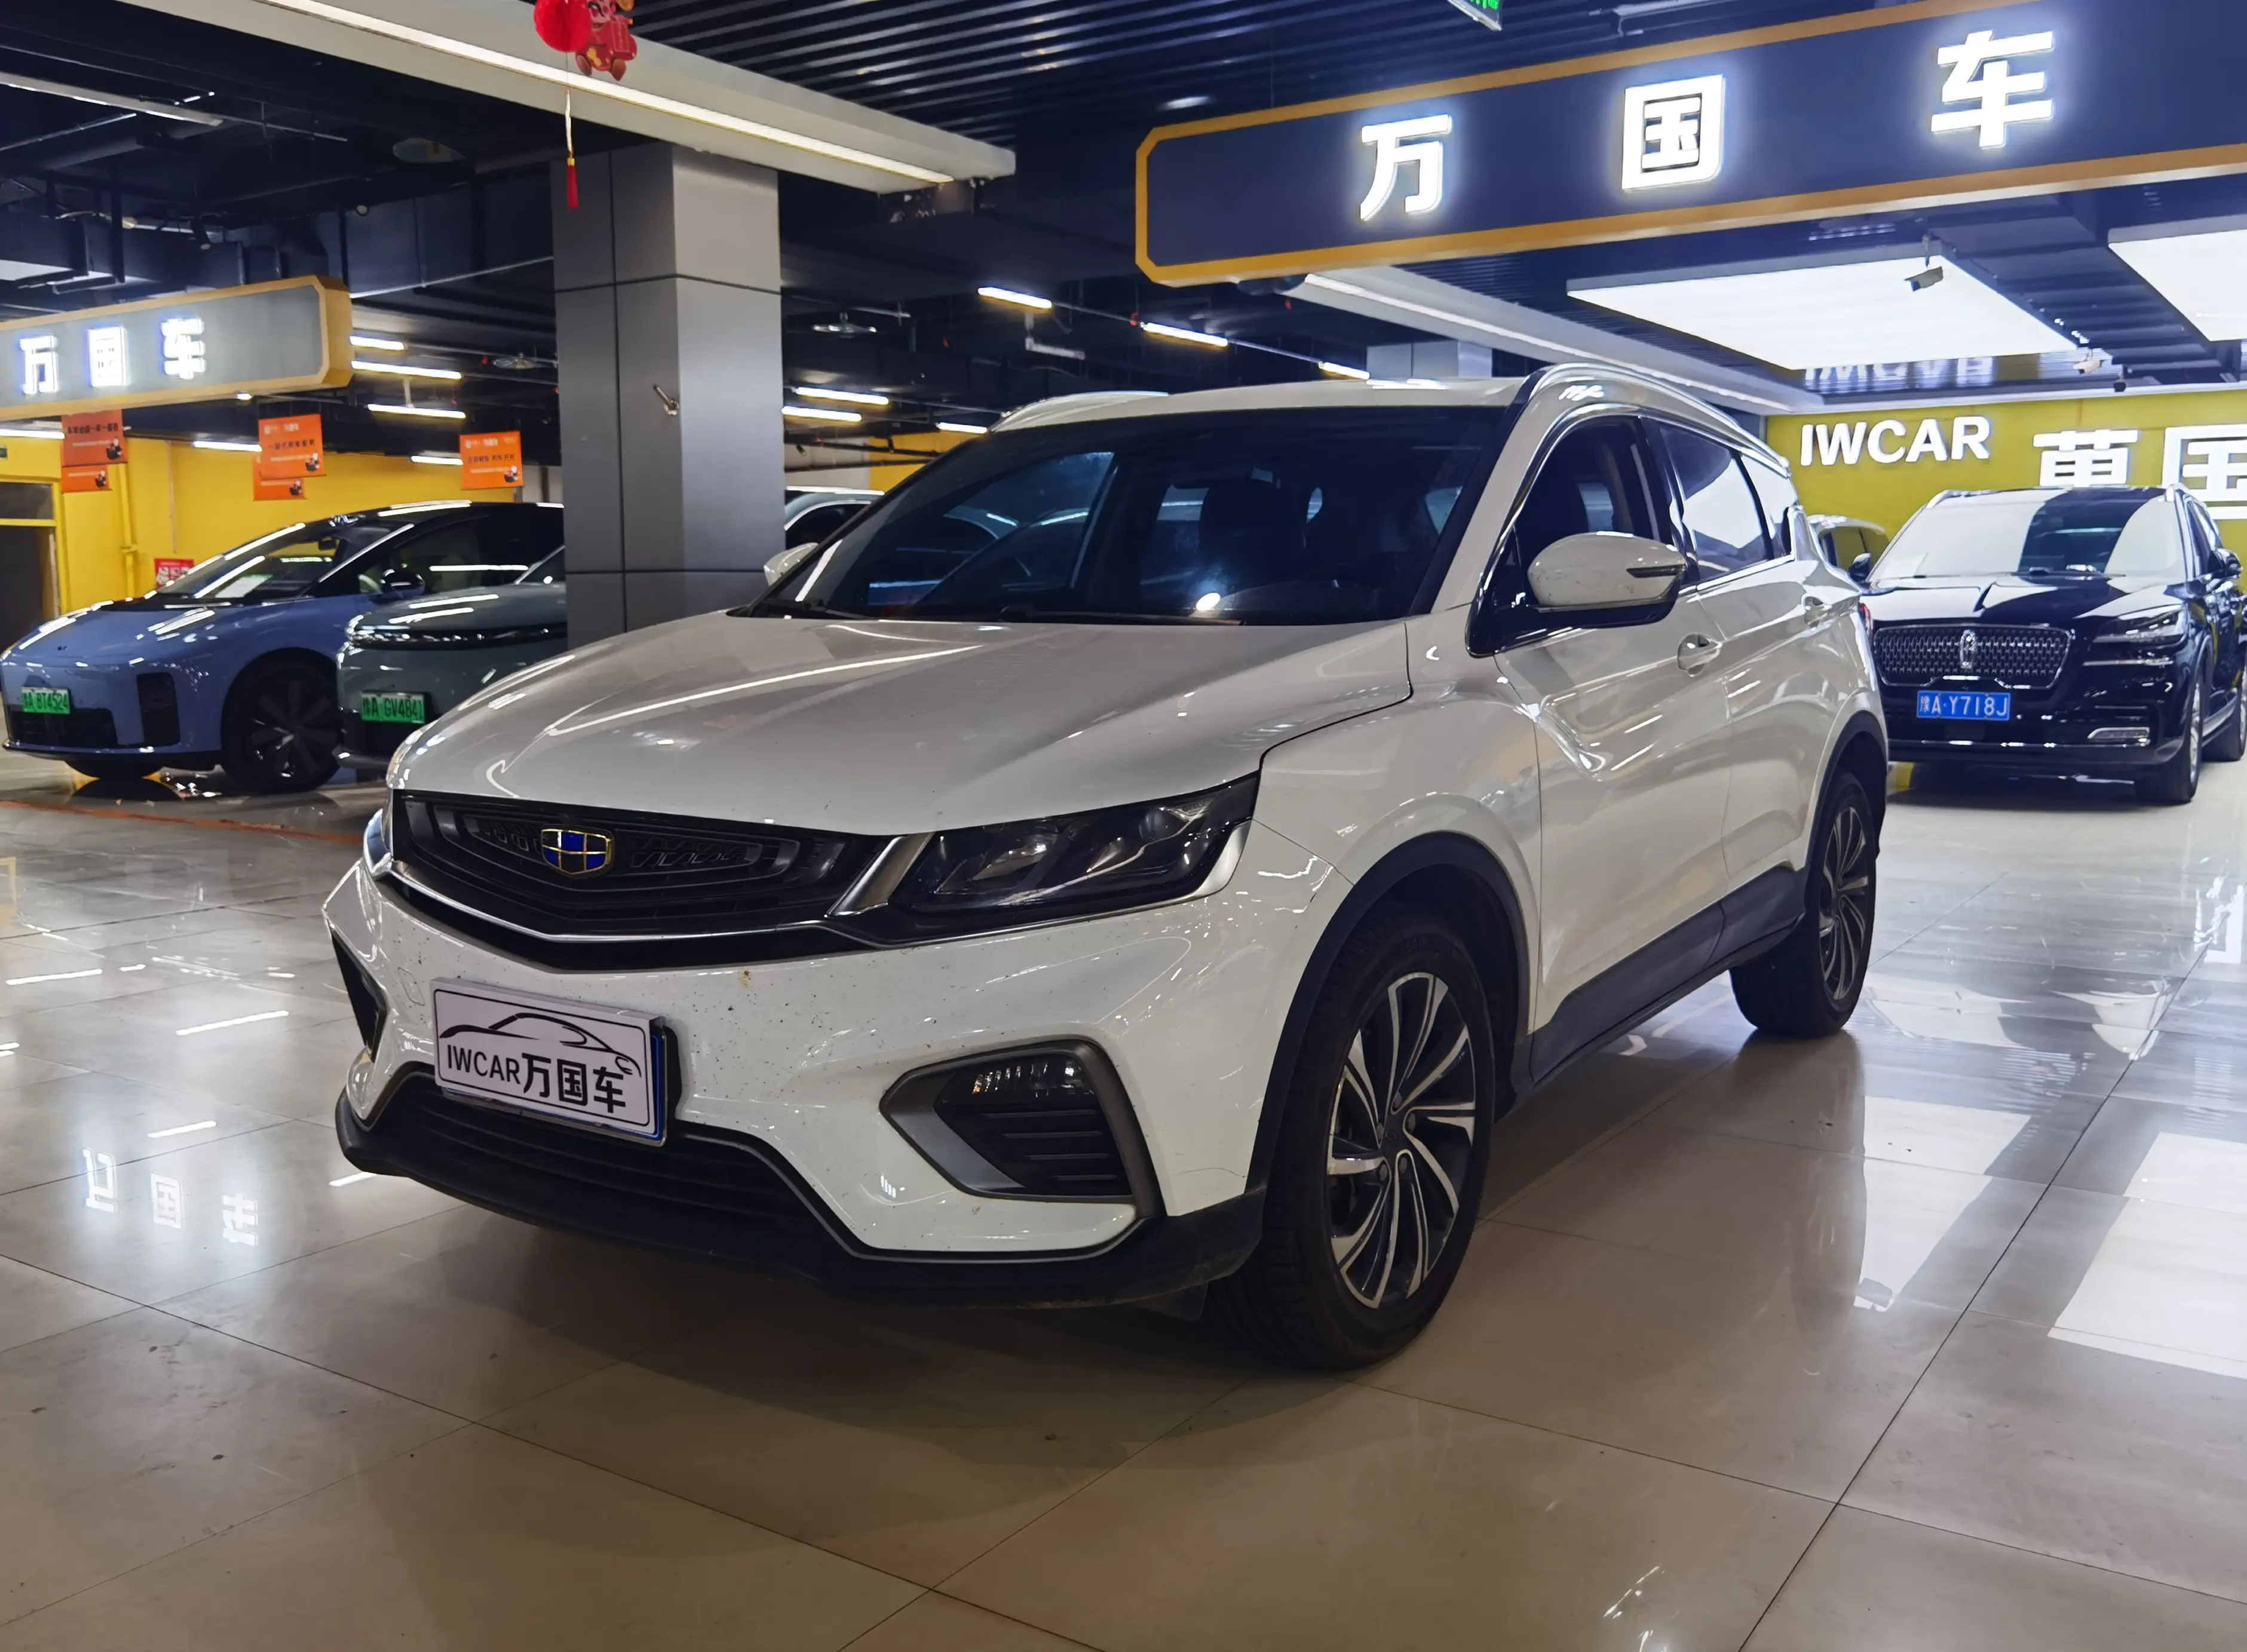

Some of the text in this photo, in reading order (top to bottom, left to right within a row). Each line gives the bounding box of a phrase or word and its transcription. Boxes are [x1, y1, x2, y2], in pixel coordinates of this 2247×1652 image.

[1359, 30, 2053, 221] 万国车
[1800, 416, 1991, 466] IWCAR
